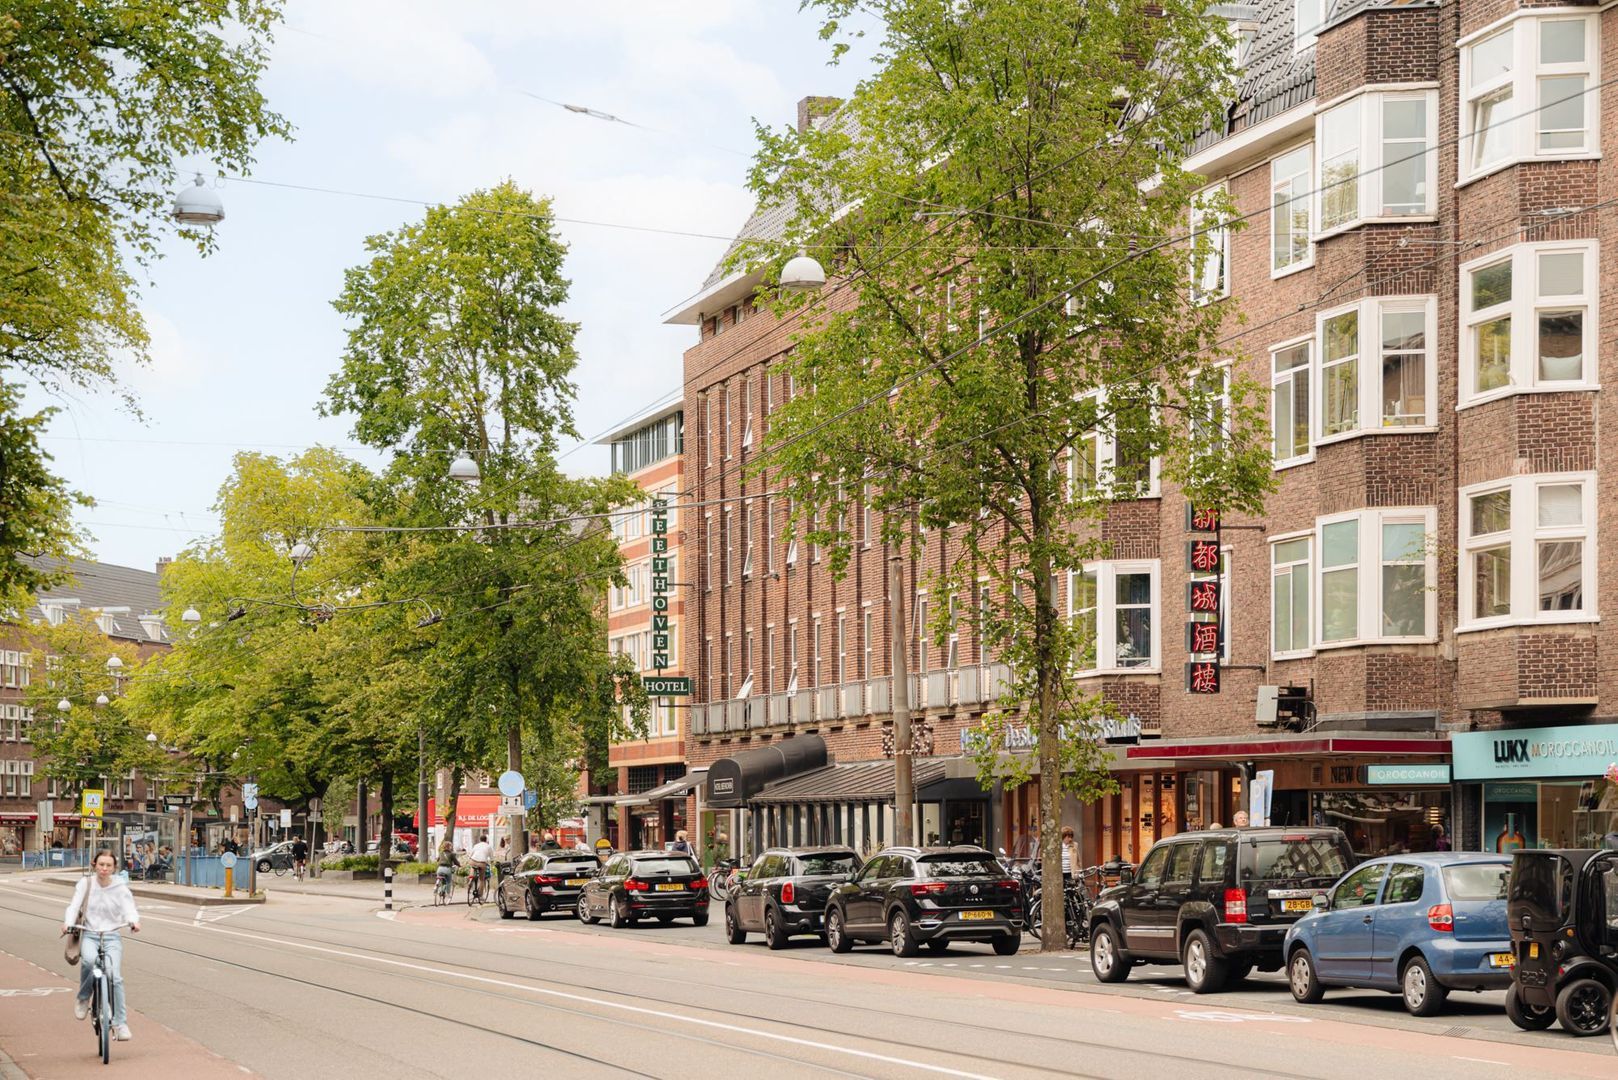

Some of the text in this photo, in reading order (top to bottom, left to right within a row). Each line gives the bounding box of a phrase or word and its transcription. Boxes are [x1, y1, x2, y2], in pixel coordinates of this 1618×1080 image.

[645, 681, 688, 692] HOTEL
[1493, 739, 1618, 763] LUKX MOROCCANOIL
[1330, 766, 1354, 784] NEW
[1371, 769, 1447, 780] OROCCANOIL
[1491, 787, 1533, 795] OROCCANOIL
